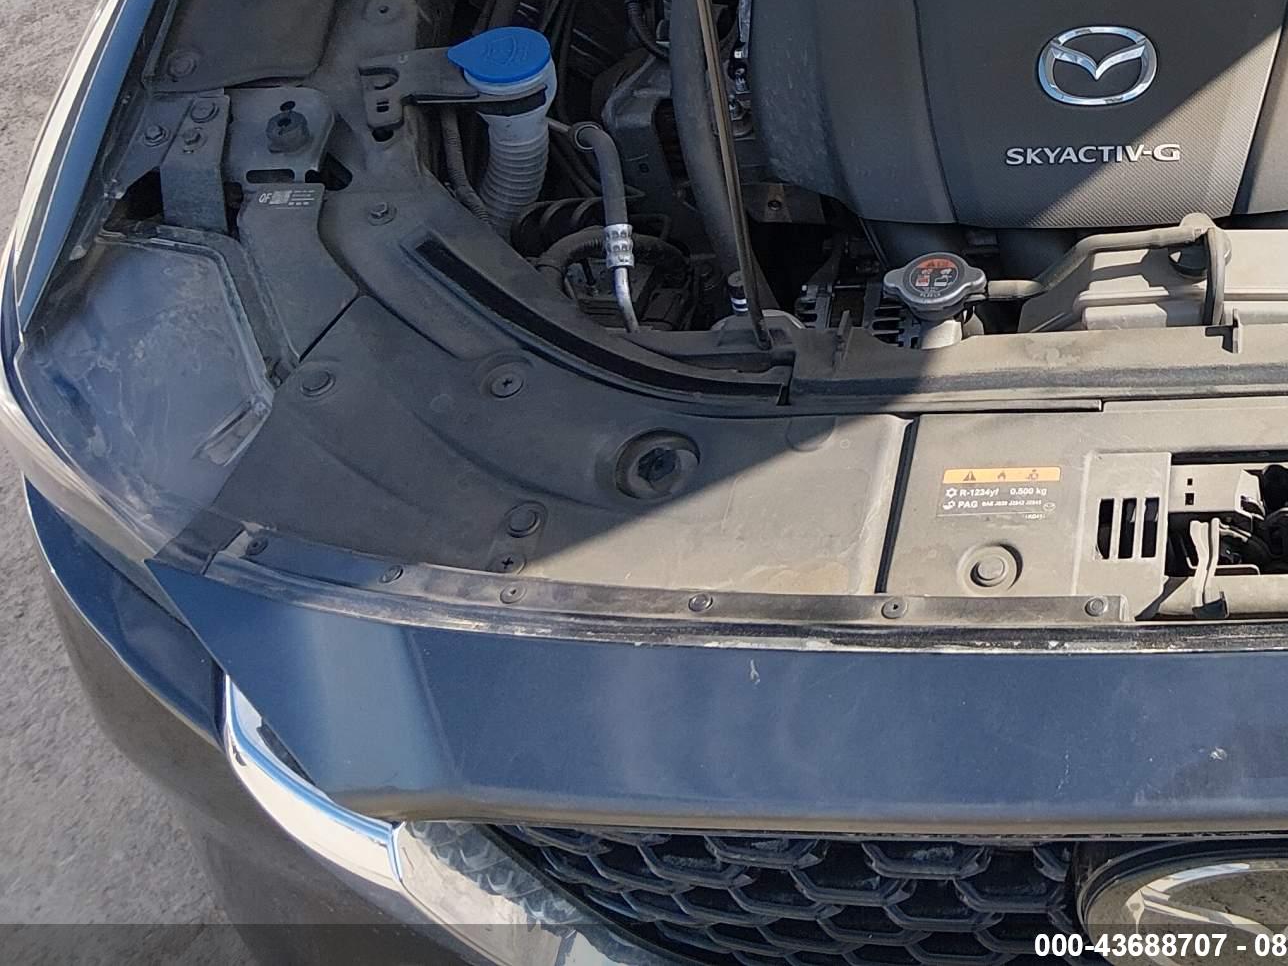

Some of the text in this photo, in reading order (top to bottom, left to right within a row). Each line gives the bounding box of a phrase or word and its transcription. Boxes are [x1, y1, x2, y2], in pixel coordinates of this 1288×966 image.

[1005, 143, 1182, 166] SKYACTIV-G
[959, 487, 1000, 498] R-1234yf
[1035, 487, 1048, 497] kg
[957, 500, 979, 509] PAG
